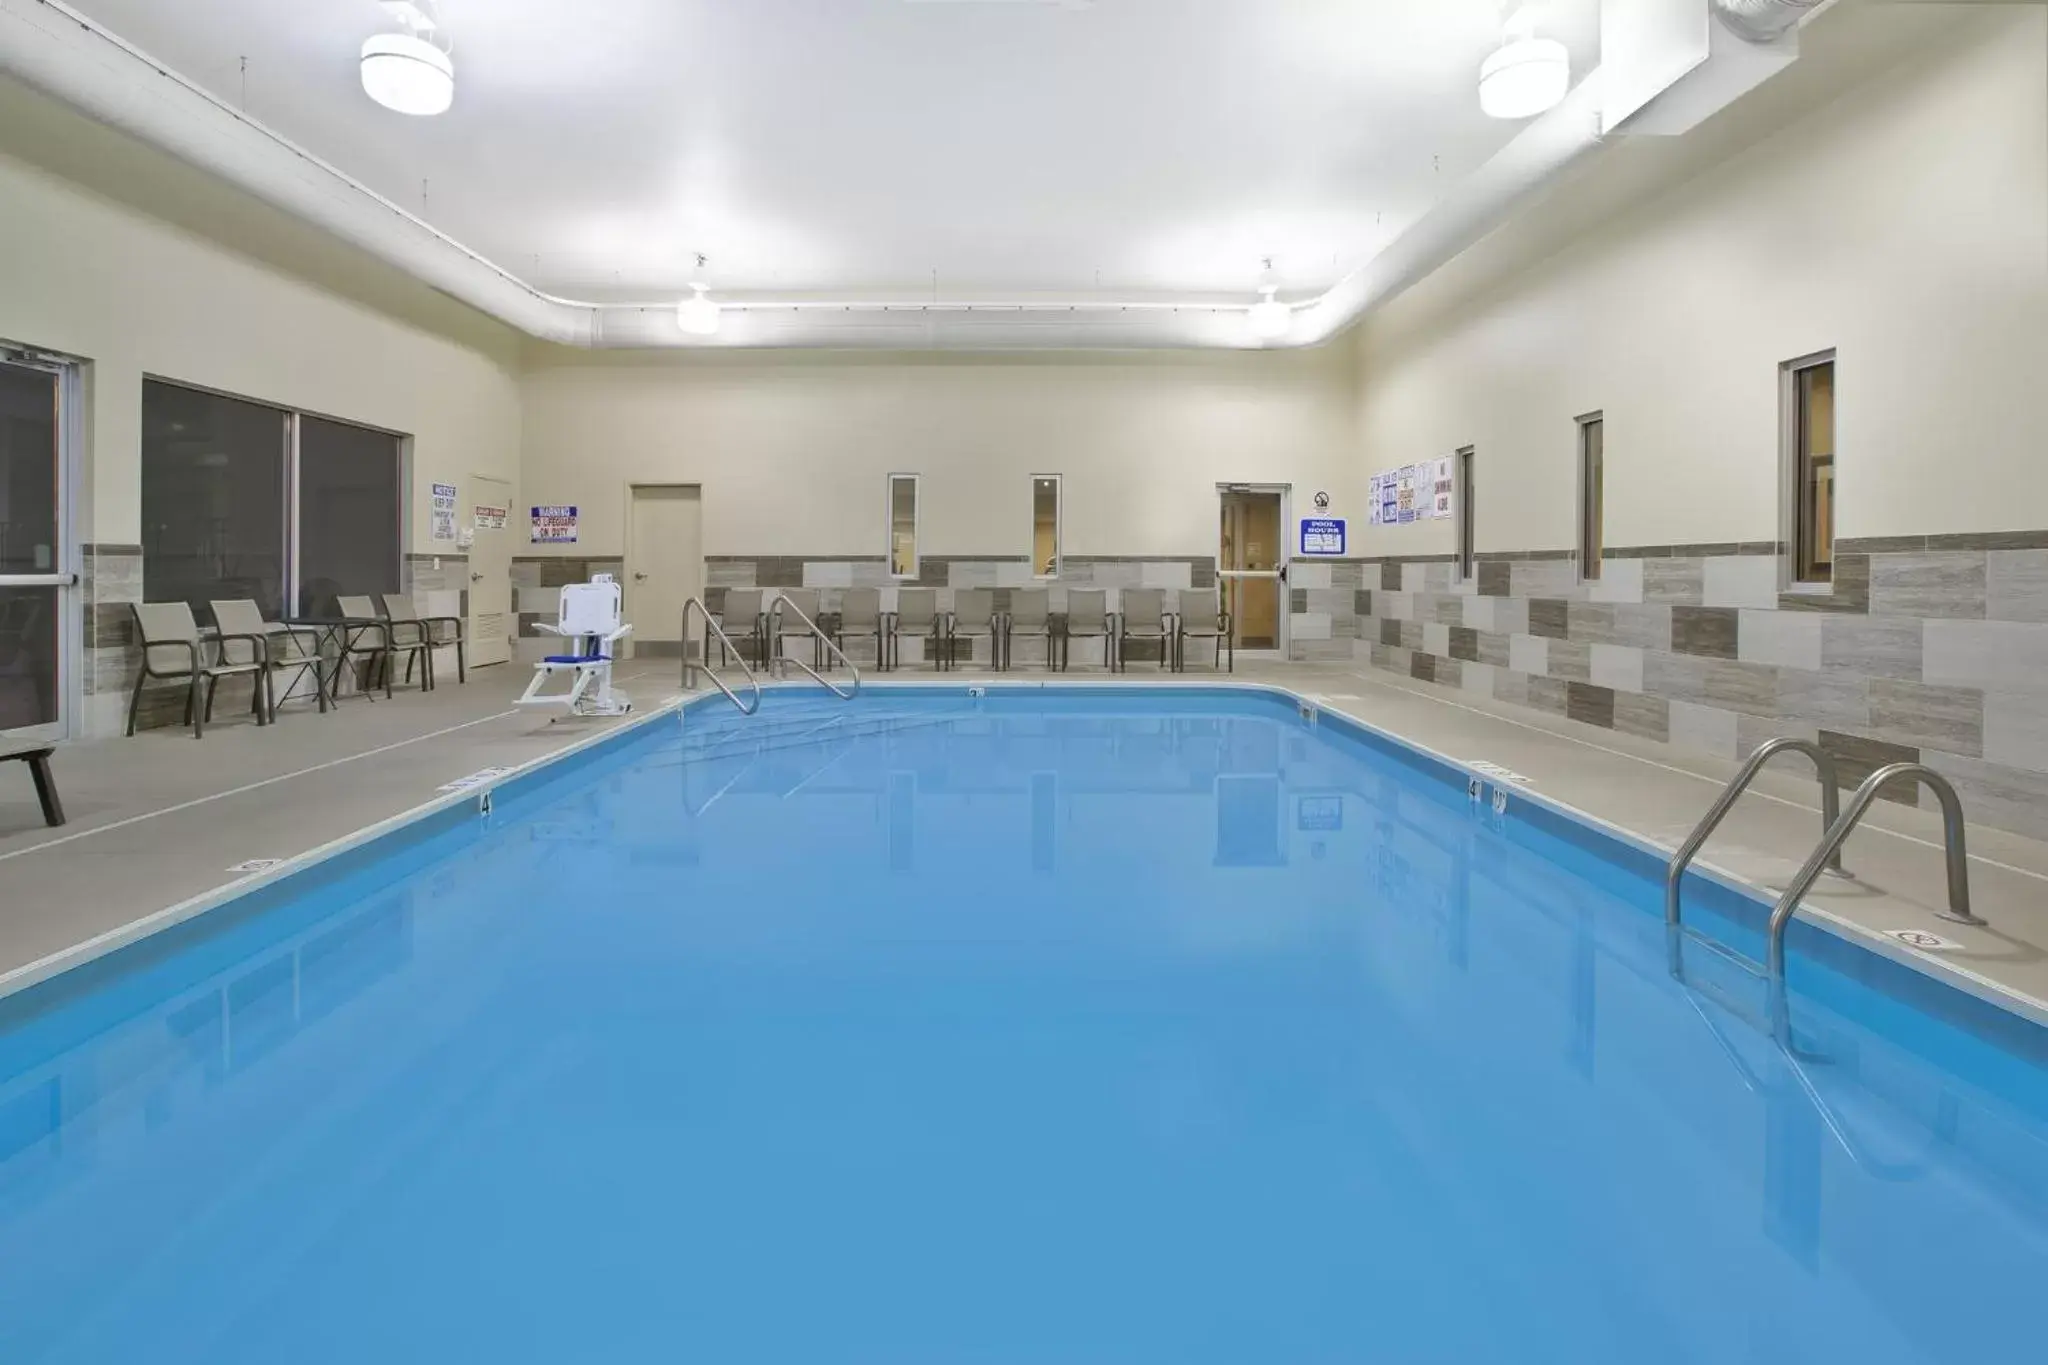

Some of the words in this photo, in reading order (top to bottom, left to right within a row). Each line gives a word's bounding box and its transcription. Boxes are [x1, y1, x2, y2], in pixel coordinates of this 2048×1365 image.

[538, 507, 570, 516] WARNING
[532, 518, 540, 526] NO
[543, 518, 576, 526] LIFEGUARD
[552, 528, 568, 536] DUTY
[482, 793, 490, 814] 4
